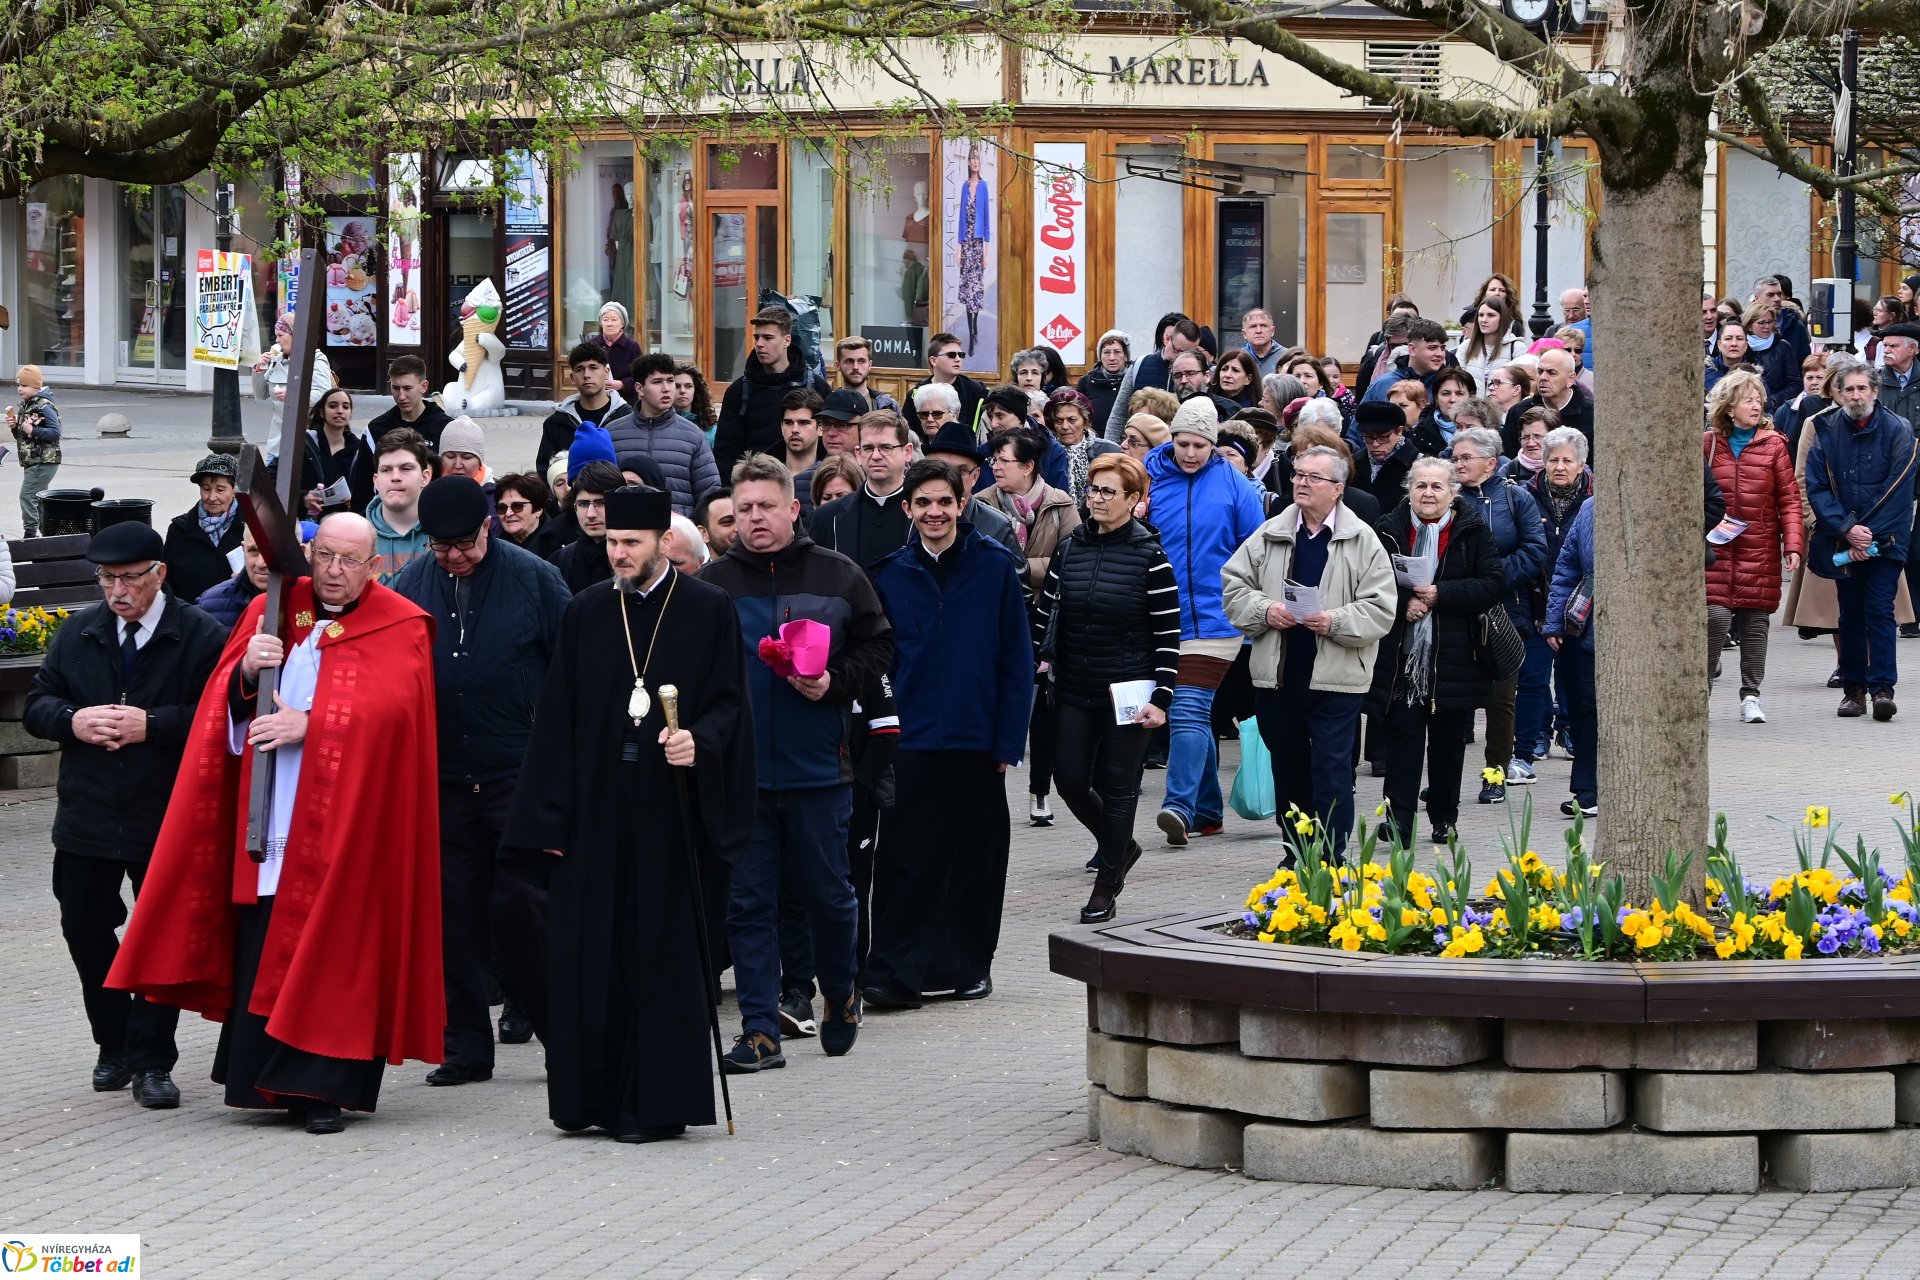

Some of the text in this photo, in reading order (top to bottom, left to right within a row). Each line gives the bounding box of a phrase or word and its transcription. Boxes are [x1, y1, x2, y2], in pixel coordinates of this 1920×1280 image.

[1108, 55, 1270, 87] MARELLA
[945, 155, 956, 268] BARCLAY
[1040, 163, 1083, 294] Lee Cooper
[199, 274, 239, 293] EMBERT
[868, 339, 916, 357] OMMA,
